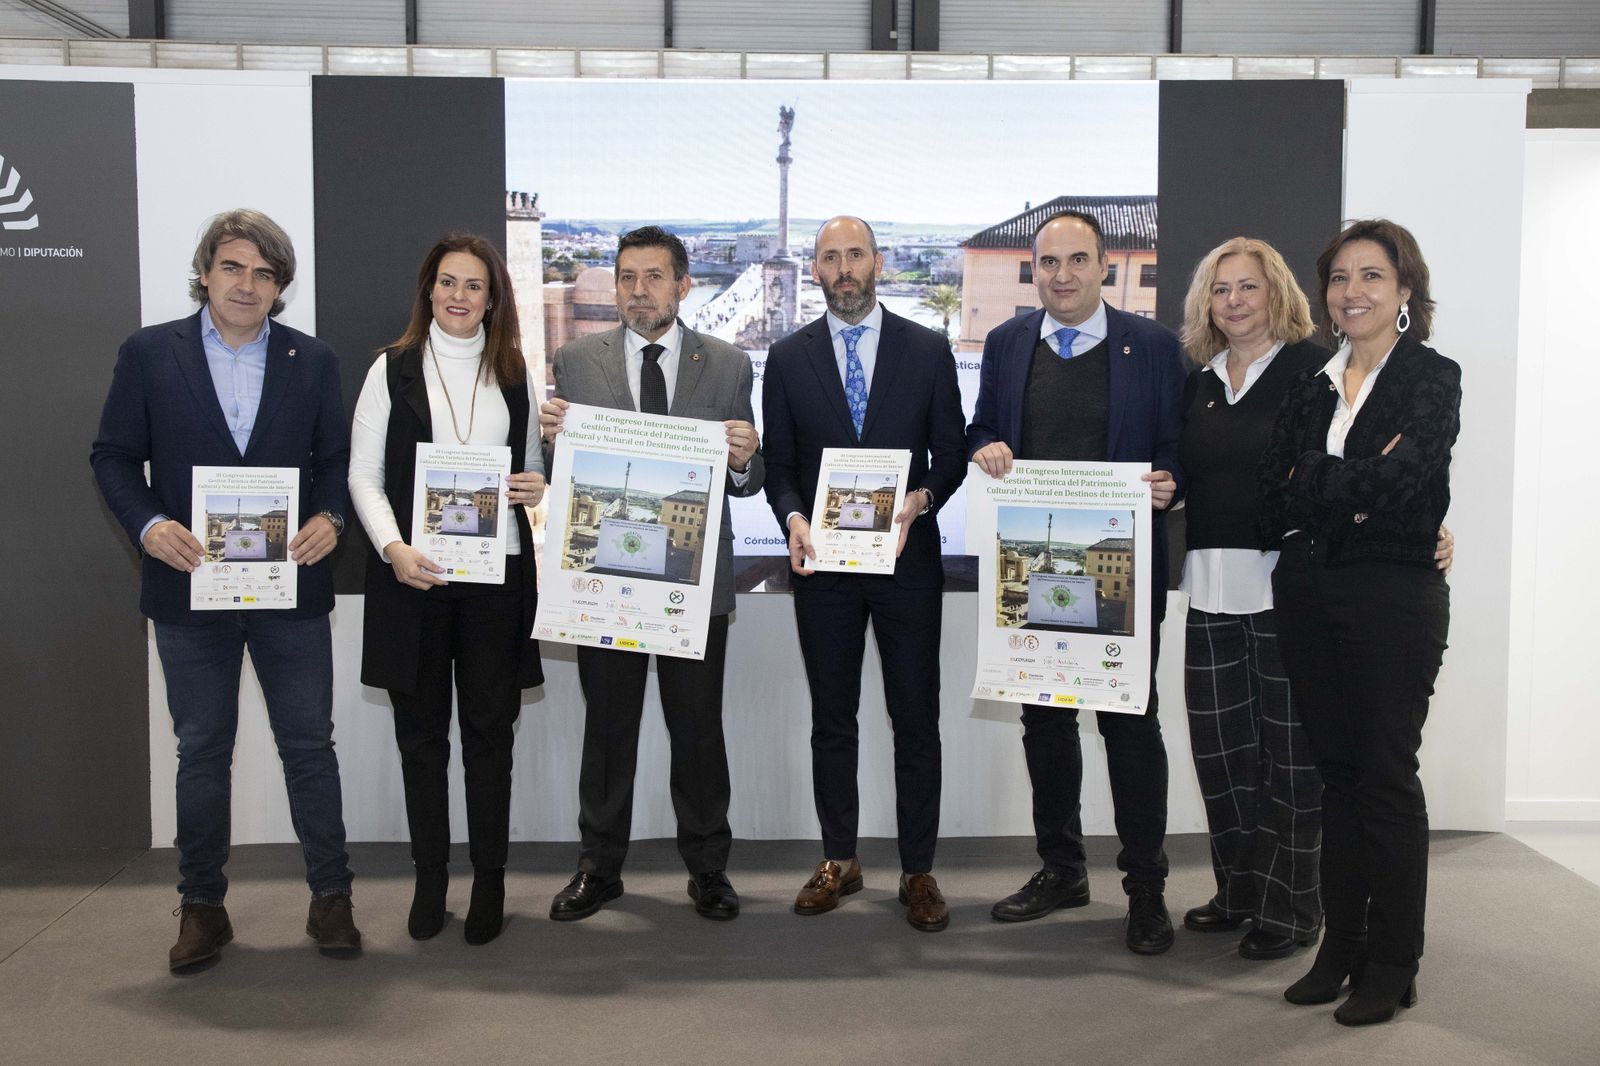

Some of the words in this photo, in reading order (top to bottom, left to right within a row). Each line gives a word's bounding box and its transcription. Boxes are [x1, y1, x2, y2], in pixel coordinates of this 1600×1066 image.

[24, 246, 84, 258] DIPUTACIÓN
[594, 413, 604, 421] III
[605, 414, 642, 426] Congreso
[644, 420, 698, 432] Internacional
[581, 422, 611, 432] Gestión
[613, 426, 648, 436] Turística
[650, 430, 662, 438] del
[664, 432, 709, 444] Patrimonio
[563, 430, 594, 440] Cultural
[603, 434, 633, 445] Natural
[646, 440, 680, 452] Destinos
[693, 445, 724, 456] Interior
[1026, 468, 1060, 476] Congreso
[1061, 468, 1113, 476] Internacional
[1003, 477, 1032, 485] Gestión
[1034, 478, 1066, 486] Turística
[1080, 479, 1127, 488] Patrimonio
[986, 487, 1016, 495] Cultural
[1024, 488, 1052, 496] Natural
[1064, 489, 1098, 498] Destinos
[1111, 490, 1146, 498] Interior
[744, 536, 786, 545] Córdoba
